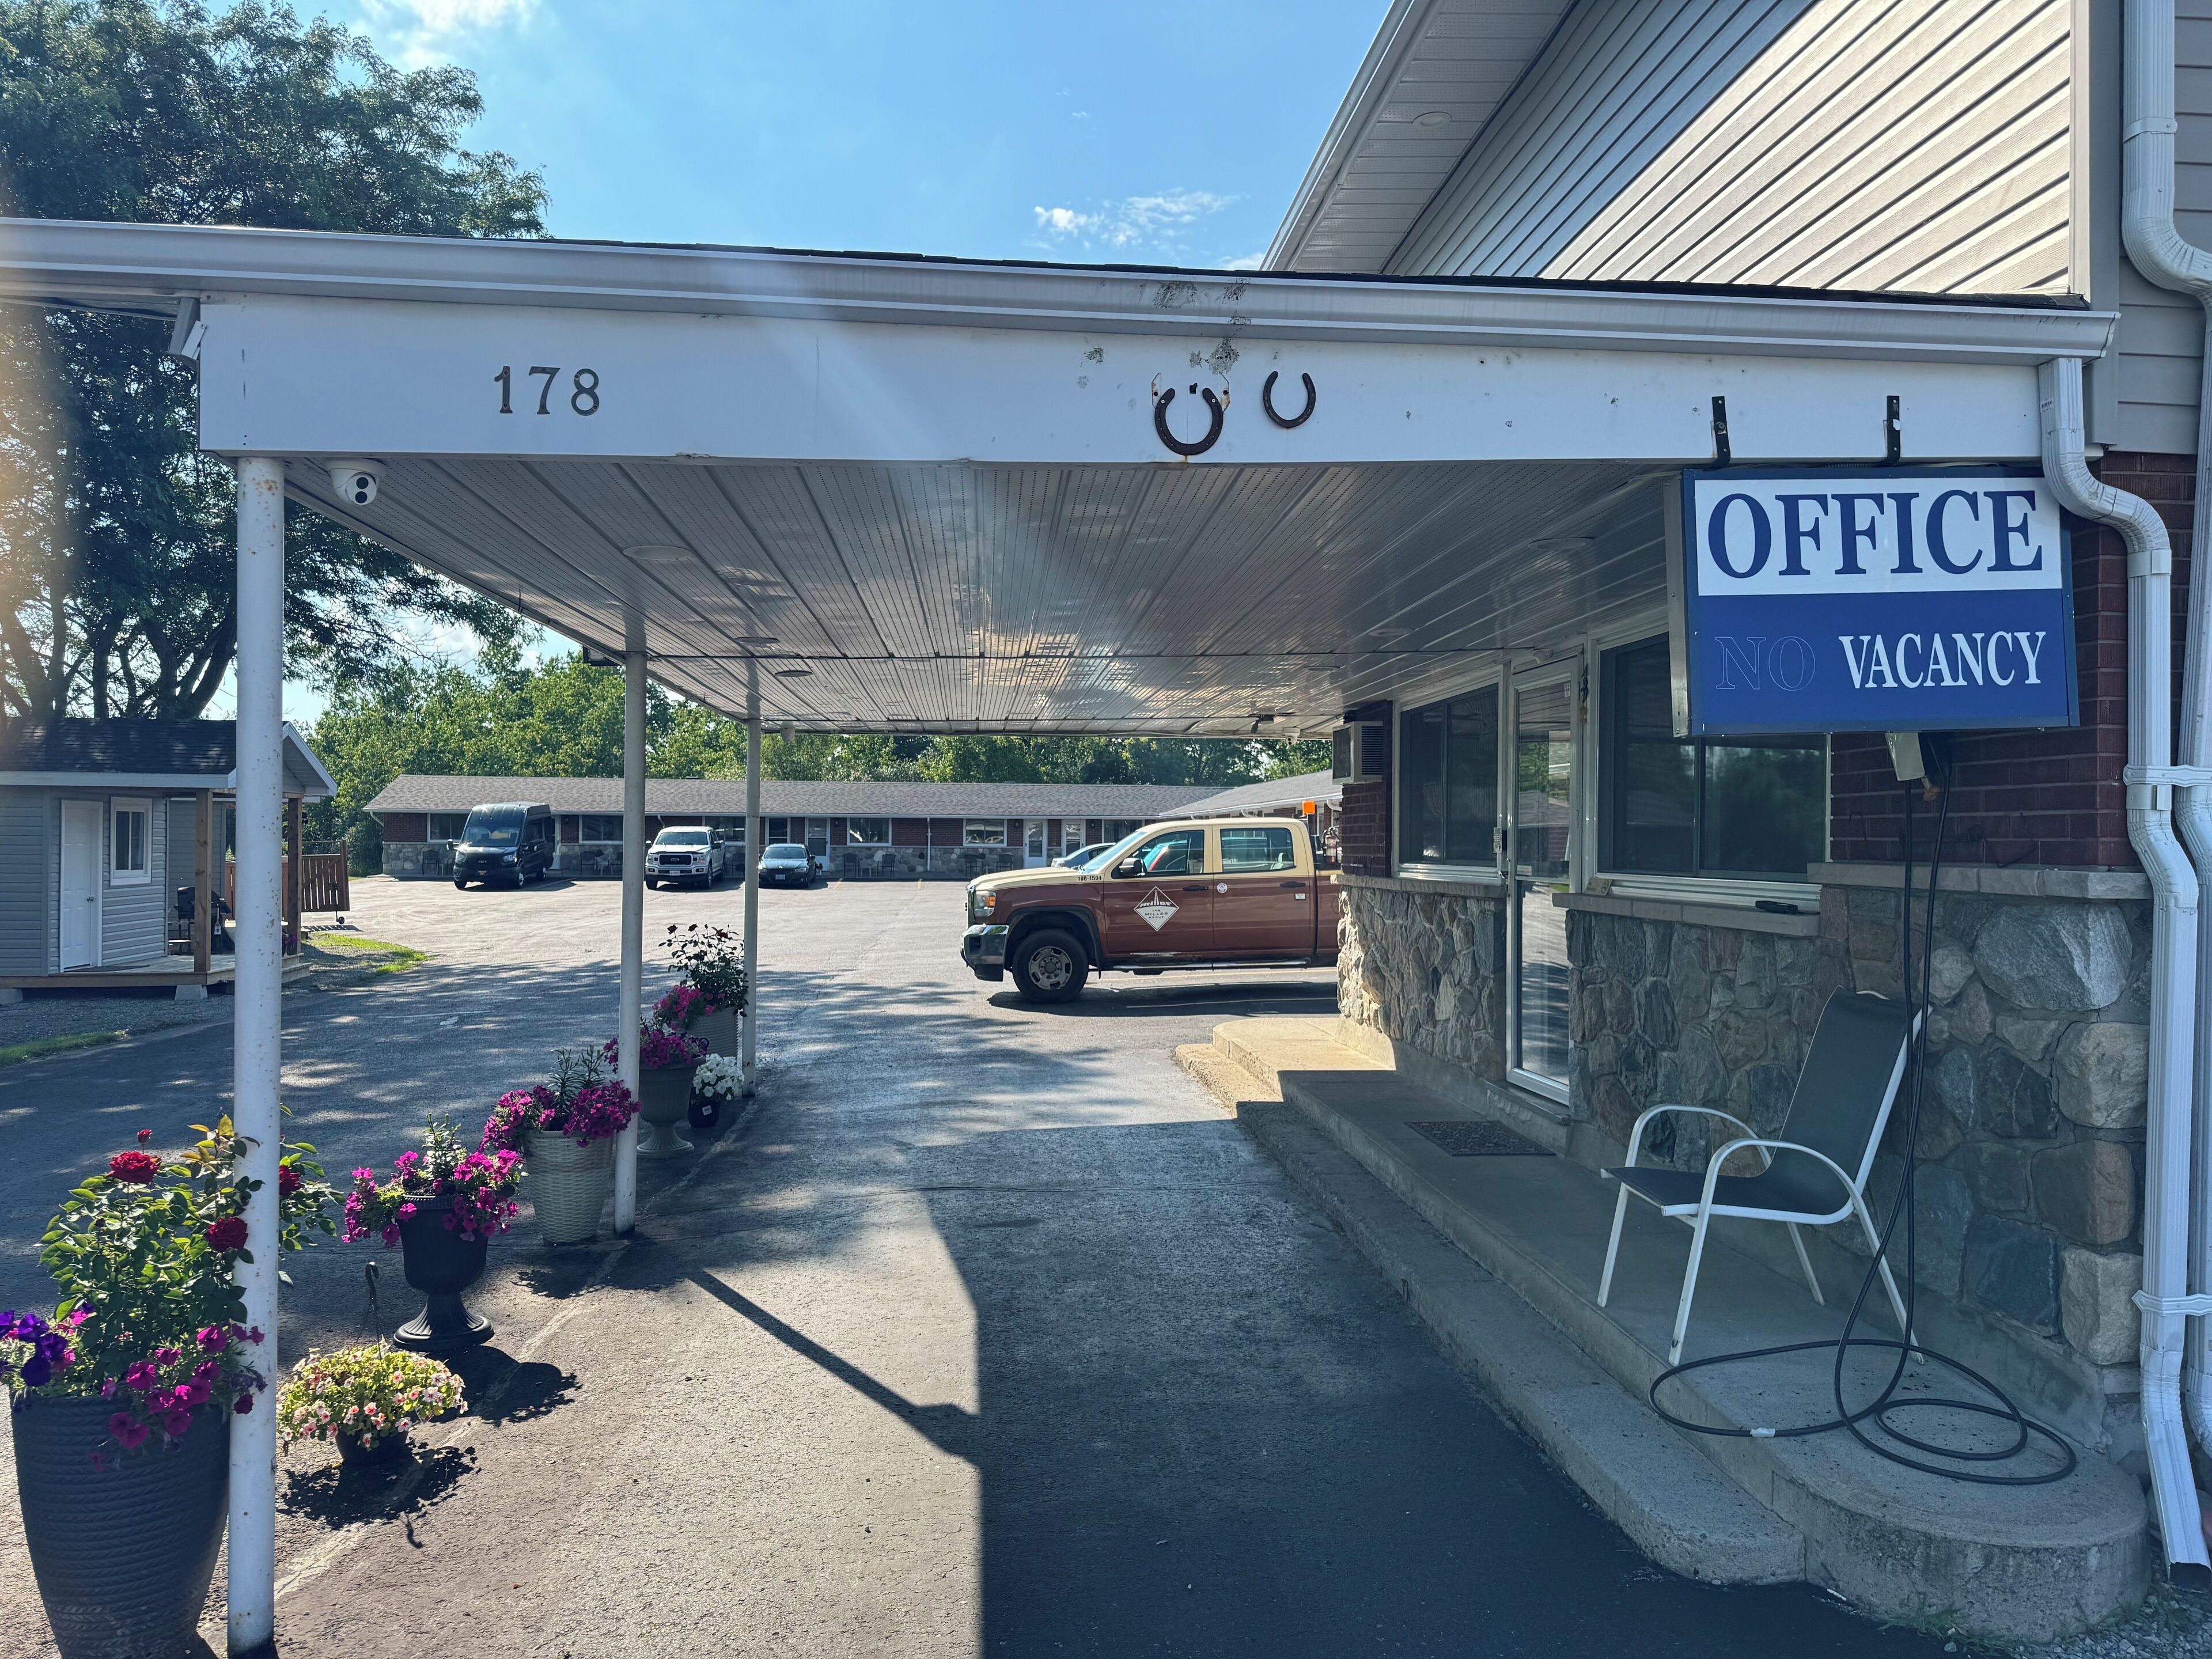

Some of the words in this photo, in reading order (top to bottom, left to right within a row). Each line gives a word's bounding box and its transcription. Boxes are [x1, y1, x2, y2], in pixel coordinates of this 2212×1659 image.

[494, 365, 600, 416] 178
[1708, 489, 2043, 579] OFFICE
[1715, 635, 1816, 691] NO
[1838, 631, 2046, 689] VACANCY
